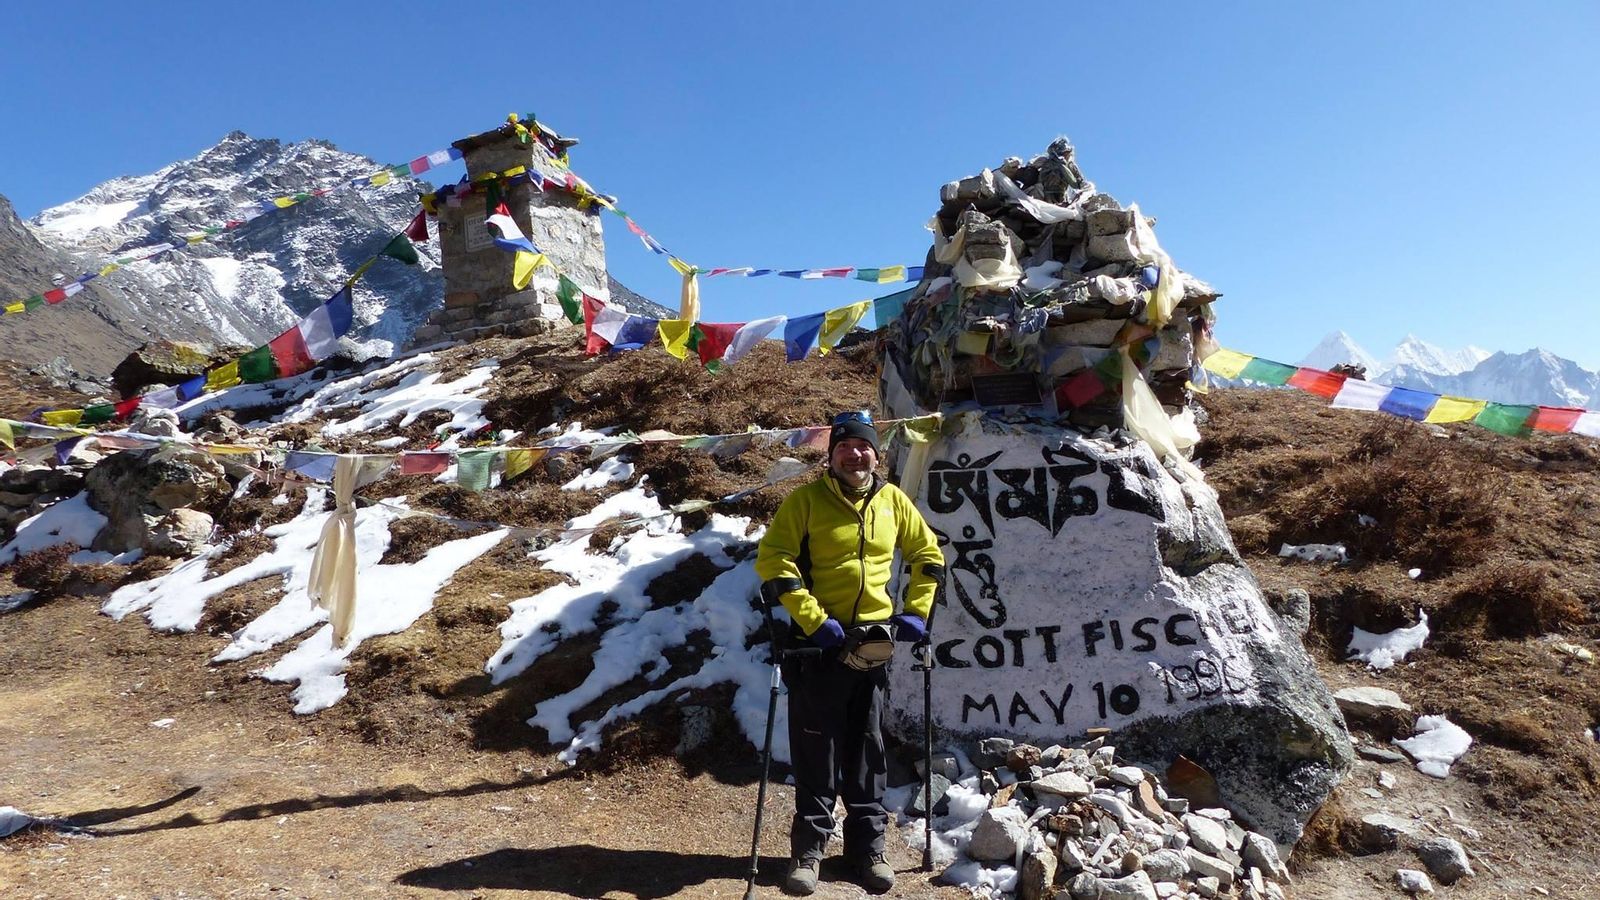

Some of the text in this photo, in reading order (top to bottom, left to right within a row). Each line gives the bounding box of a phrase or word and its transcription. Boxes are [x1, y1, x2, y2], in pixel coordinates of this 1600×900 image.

[911, 625, 1061, 671] SCOTT
[962, 656, 1249, 726] MAY 10 1996
